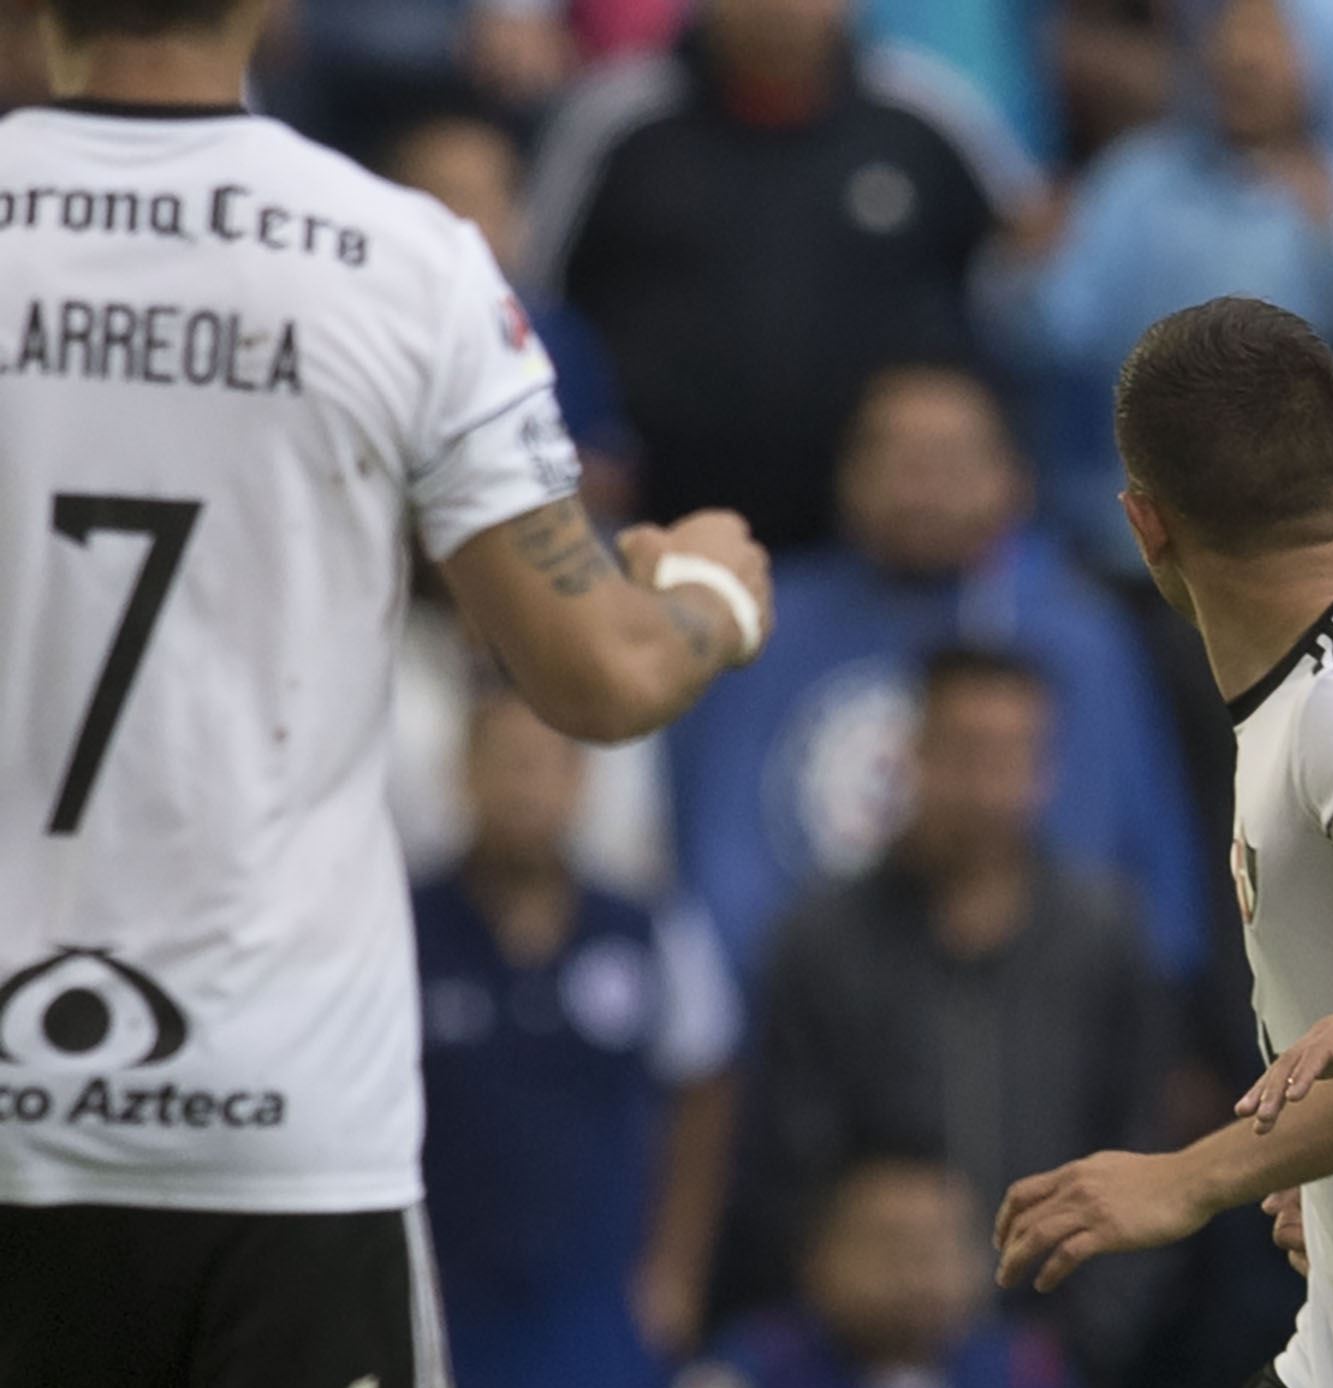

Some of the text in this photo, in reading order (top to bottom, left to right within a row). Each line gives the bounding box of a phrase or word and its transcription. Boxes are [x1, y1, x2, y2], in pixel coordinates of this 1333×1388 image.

[0, 187, 196, 244] rona
[47, 492, 206, 837] 7
[66, 1074, 287, 1130] Azteca
